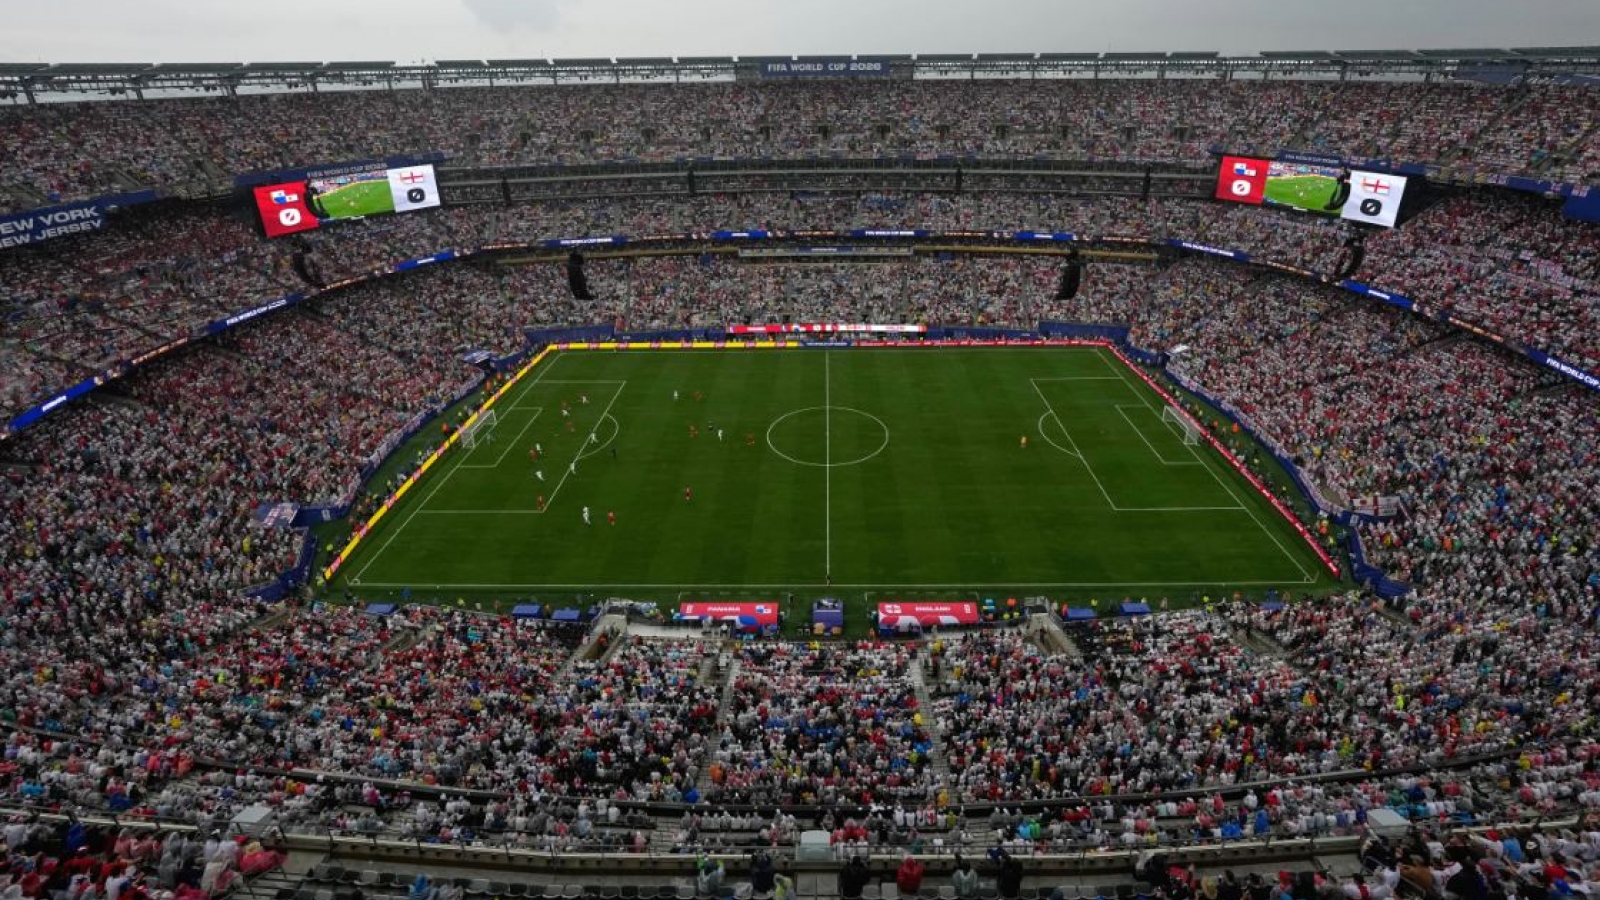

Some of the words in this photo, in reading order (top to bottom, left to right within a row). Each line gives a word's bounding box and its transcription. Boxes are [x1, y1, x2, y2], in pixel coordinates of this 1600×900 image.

[767, 63, 787, 72] FIFA
[790, 63, 823, 72] WORLD
[828, 62, 846, 71] CUP
[850, 62, 881, 71] 2026
[0, 218, 34, 235] EW
[38, 206, 100, 227] YORK
[35, 219, 102, 241] JERSEY
